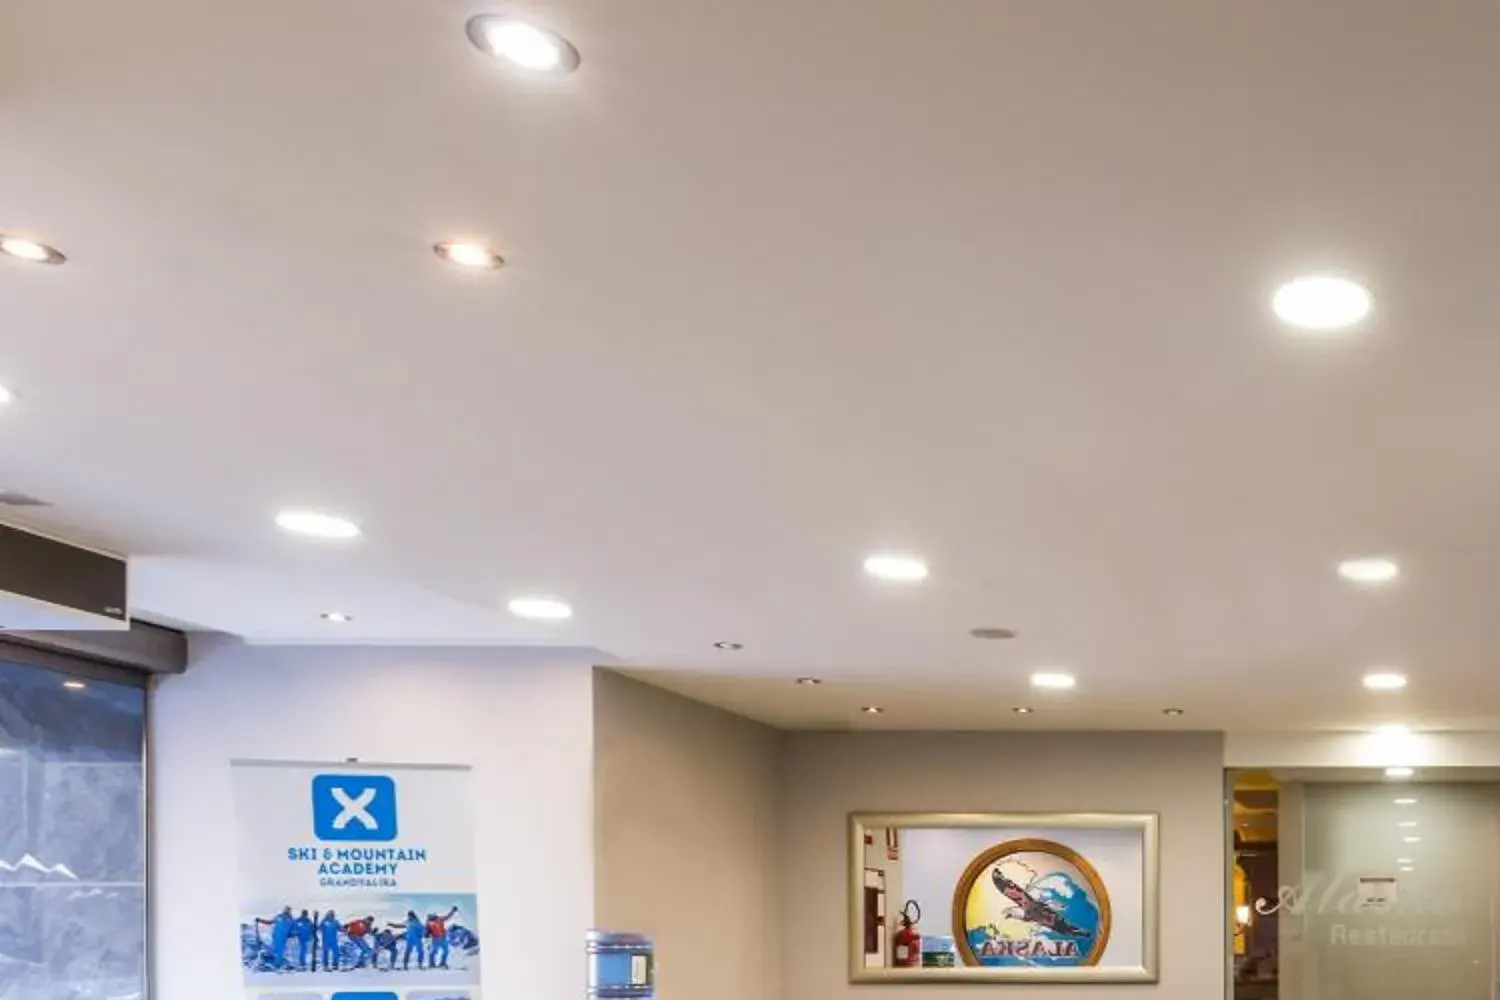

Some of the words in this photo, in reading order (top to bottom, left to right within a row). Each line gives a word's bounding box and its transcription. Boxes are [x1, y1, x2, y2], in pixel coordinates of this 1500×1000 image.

[288, 847, 317, 860] SKI
[323, 848, 333, 860] &
[337, 848, 427, 861] MOUNTAIN
[317, 863, 398, 875] ACADEMY
